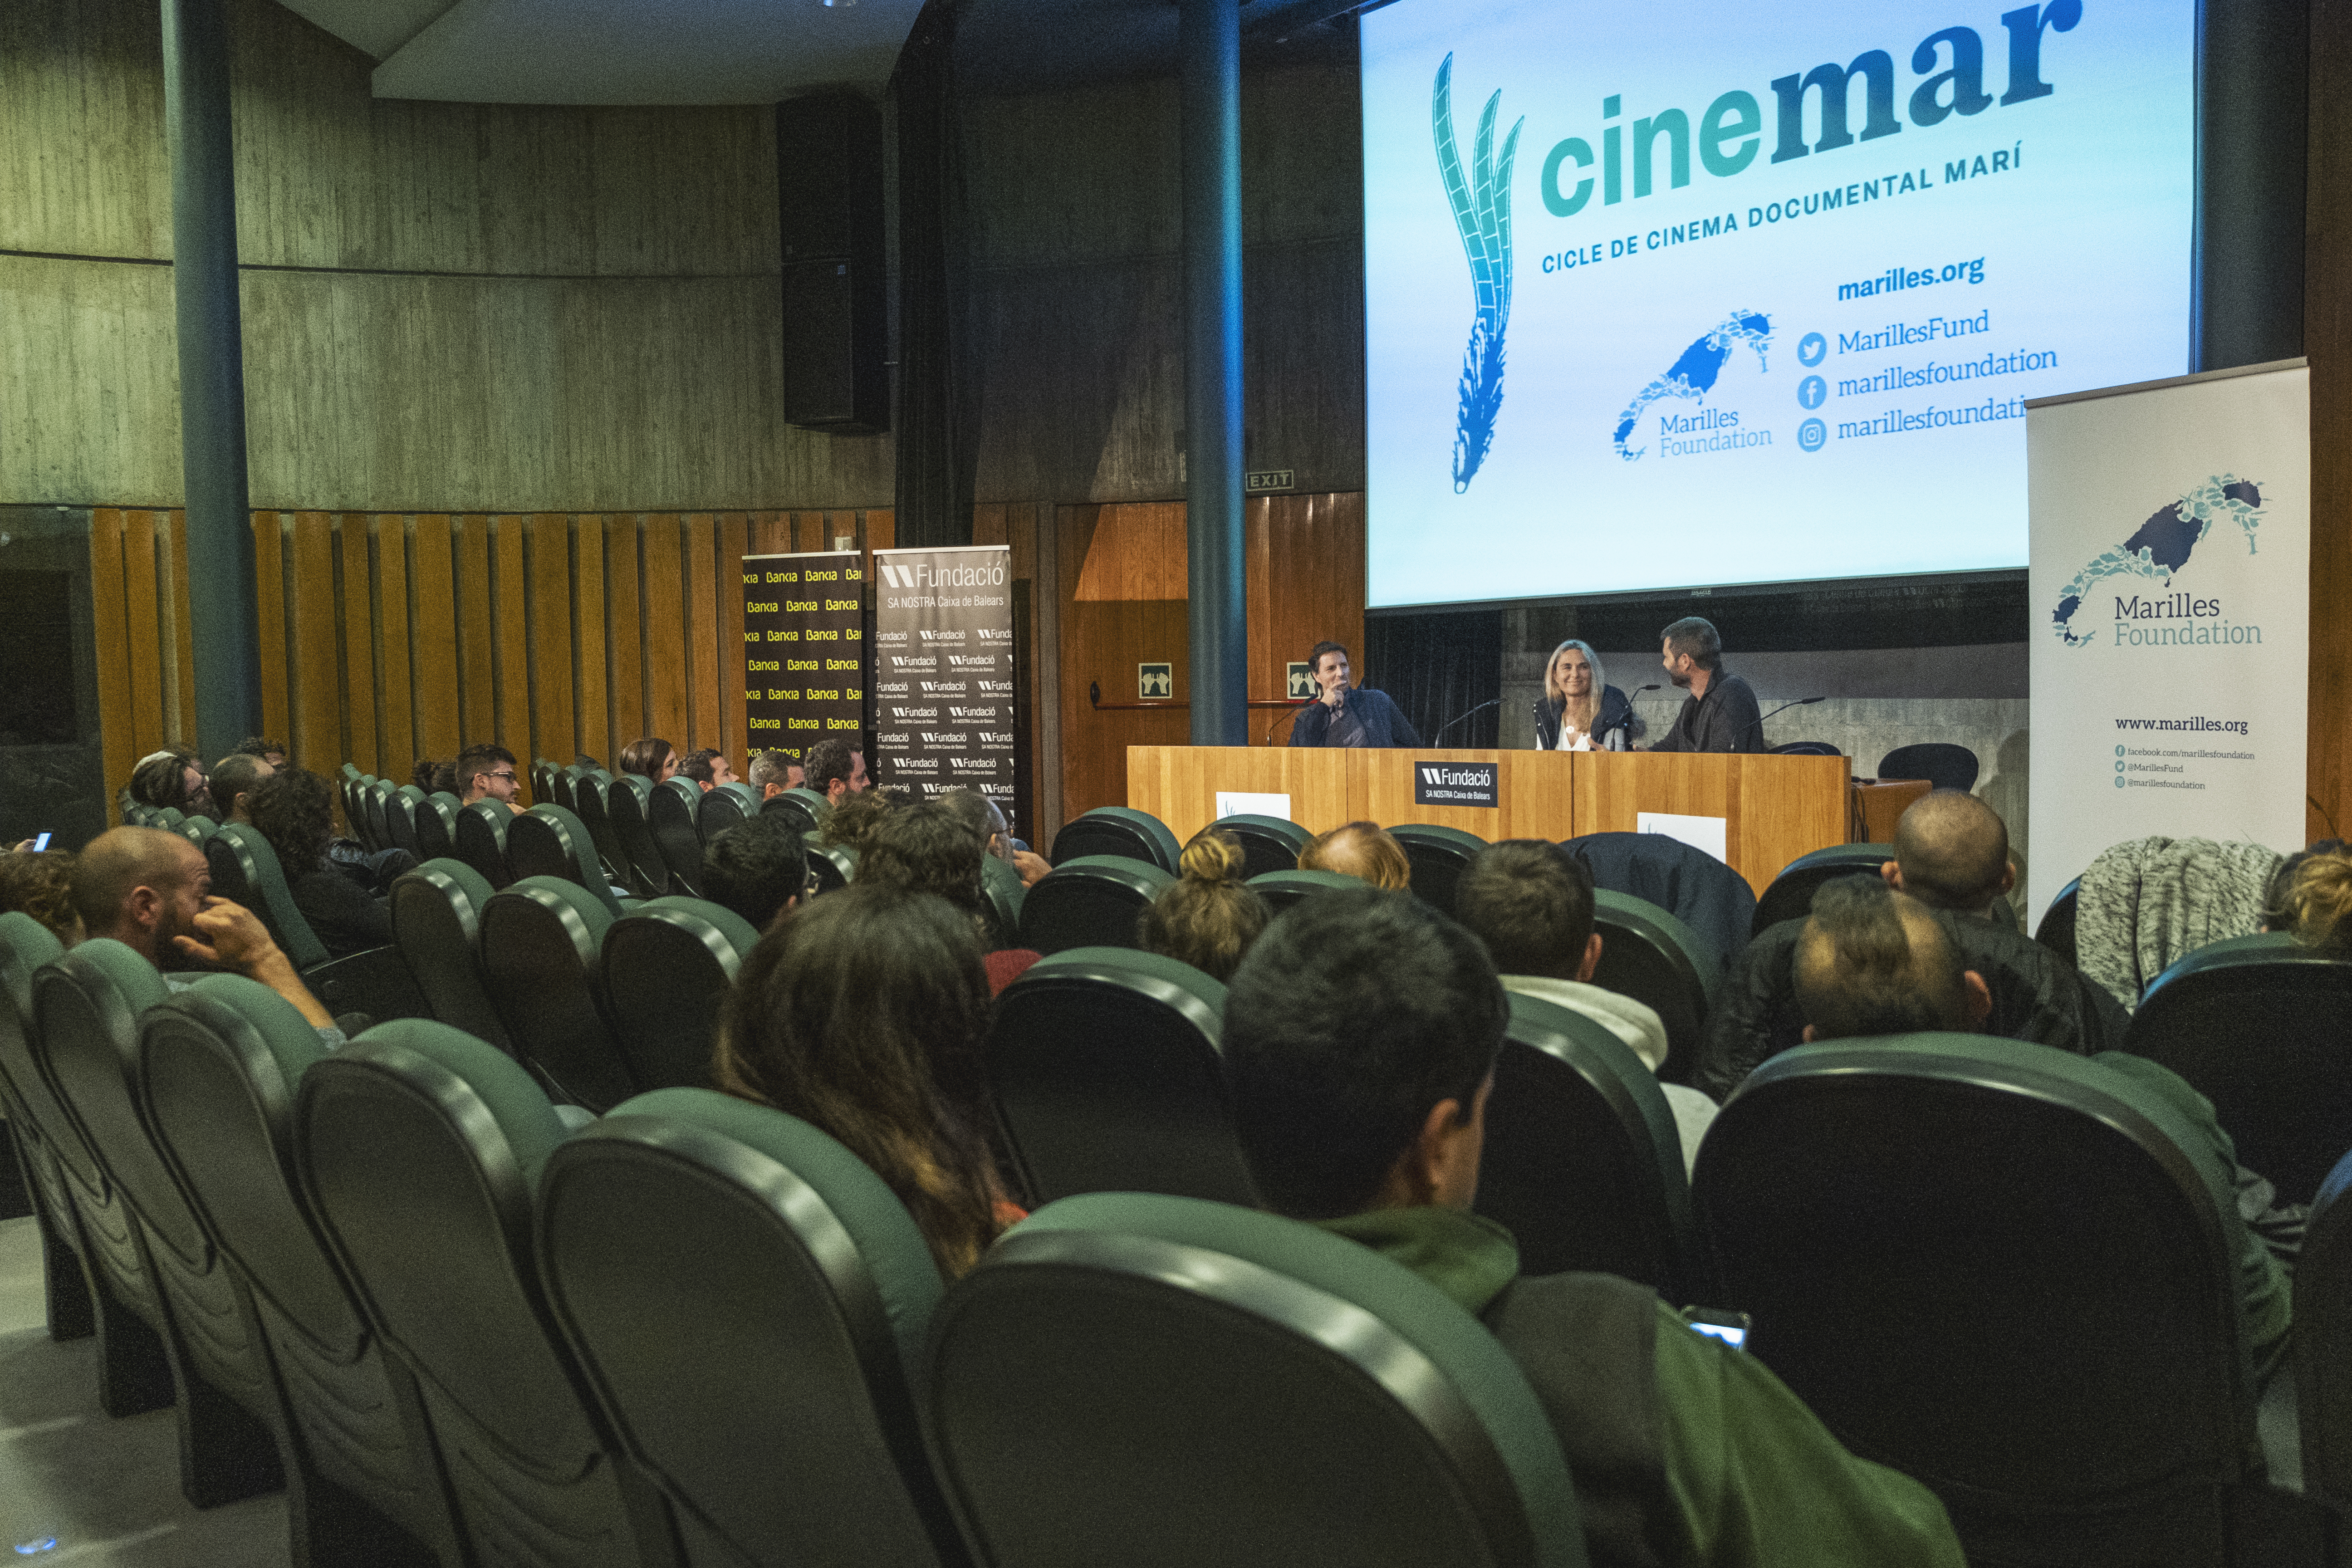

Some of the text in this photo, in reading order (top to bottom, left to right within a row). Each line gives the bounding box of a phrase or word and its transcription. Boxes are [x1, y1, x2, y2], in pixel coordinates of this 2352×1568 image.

[1541, 0, 2082, 217] cinemar
[1542, 140, 2022, 273] CICLE DE CINEMA DOCUMENTAL MARÍ
[1838, 256, 1985, 301] marilles.org
[1838, 309, 1989, 354] MarillesFund
[1838, 348, 2058, 397] marillesfoundation
[1660, 408, 1739, 436] Marilles
[1661, 427, 1772, 457] Foundation
[1250, 473, 1289, 487] EXIT
[767, 572, 797, 583] Bankia
[806, 571, 837, 581] Bankia
[917, 561, 1004, 588] Fundació
[748, 599, 858, 612] Bankia Bankia Bankia
[888, 595, 1004, 608] SA NOSTRA Caixa de Balears
[2115, 593, 2220, 619] Marilles
[768, 631, 798, 641] Bankia
[806, 630, 838, 641] Bankia
[876, 632, 907, 640] Fundació
[933, 630, 965, 639] Fundació
[2115, 620, 2262, 646] Foundation
[749, 659, 858, 671] Bankia Bankia Bankia
[904, 656, 936, 666] Fundació
[962, 655, 995, 665] Fundació
[877, 682, 908, 691] Fundació
[933, 681, 966, 691] Fundació
[769, 689, 799, 700] Bankia
[807, 689, 838, 700] Bankia
[905, 707, 937, 716] Fundació
[963, 706, 996, 716] Fundació
[750, 718, 858, 729] Bankia Bankia Bankia
[2116, 717, 2248, 735] www.marilles.org
[877, 733, 909, 742] Fundació
[934, 733, 967, 742] Fundació
[2128, 748, 2255, 760] facebook.com/marillesfoundation
[906, 758, 938, 767] Fundació
[964, 758, 996, 767] Fundació
[2127, 764, 2183, 773] @MarillesFund
[1442, 769, 1490, 786] Fundació
[2127, 779, 2205, 789] @marillesfoundation
[1433, 790, 1453, 799] NOSTRA
[1454, 791, 1466, 799] Caixa
[1474, 792, 1490, 800] Balears
